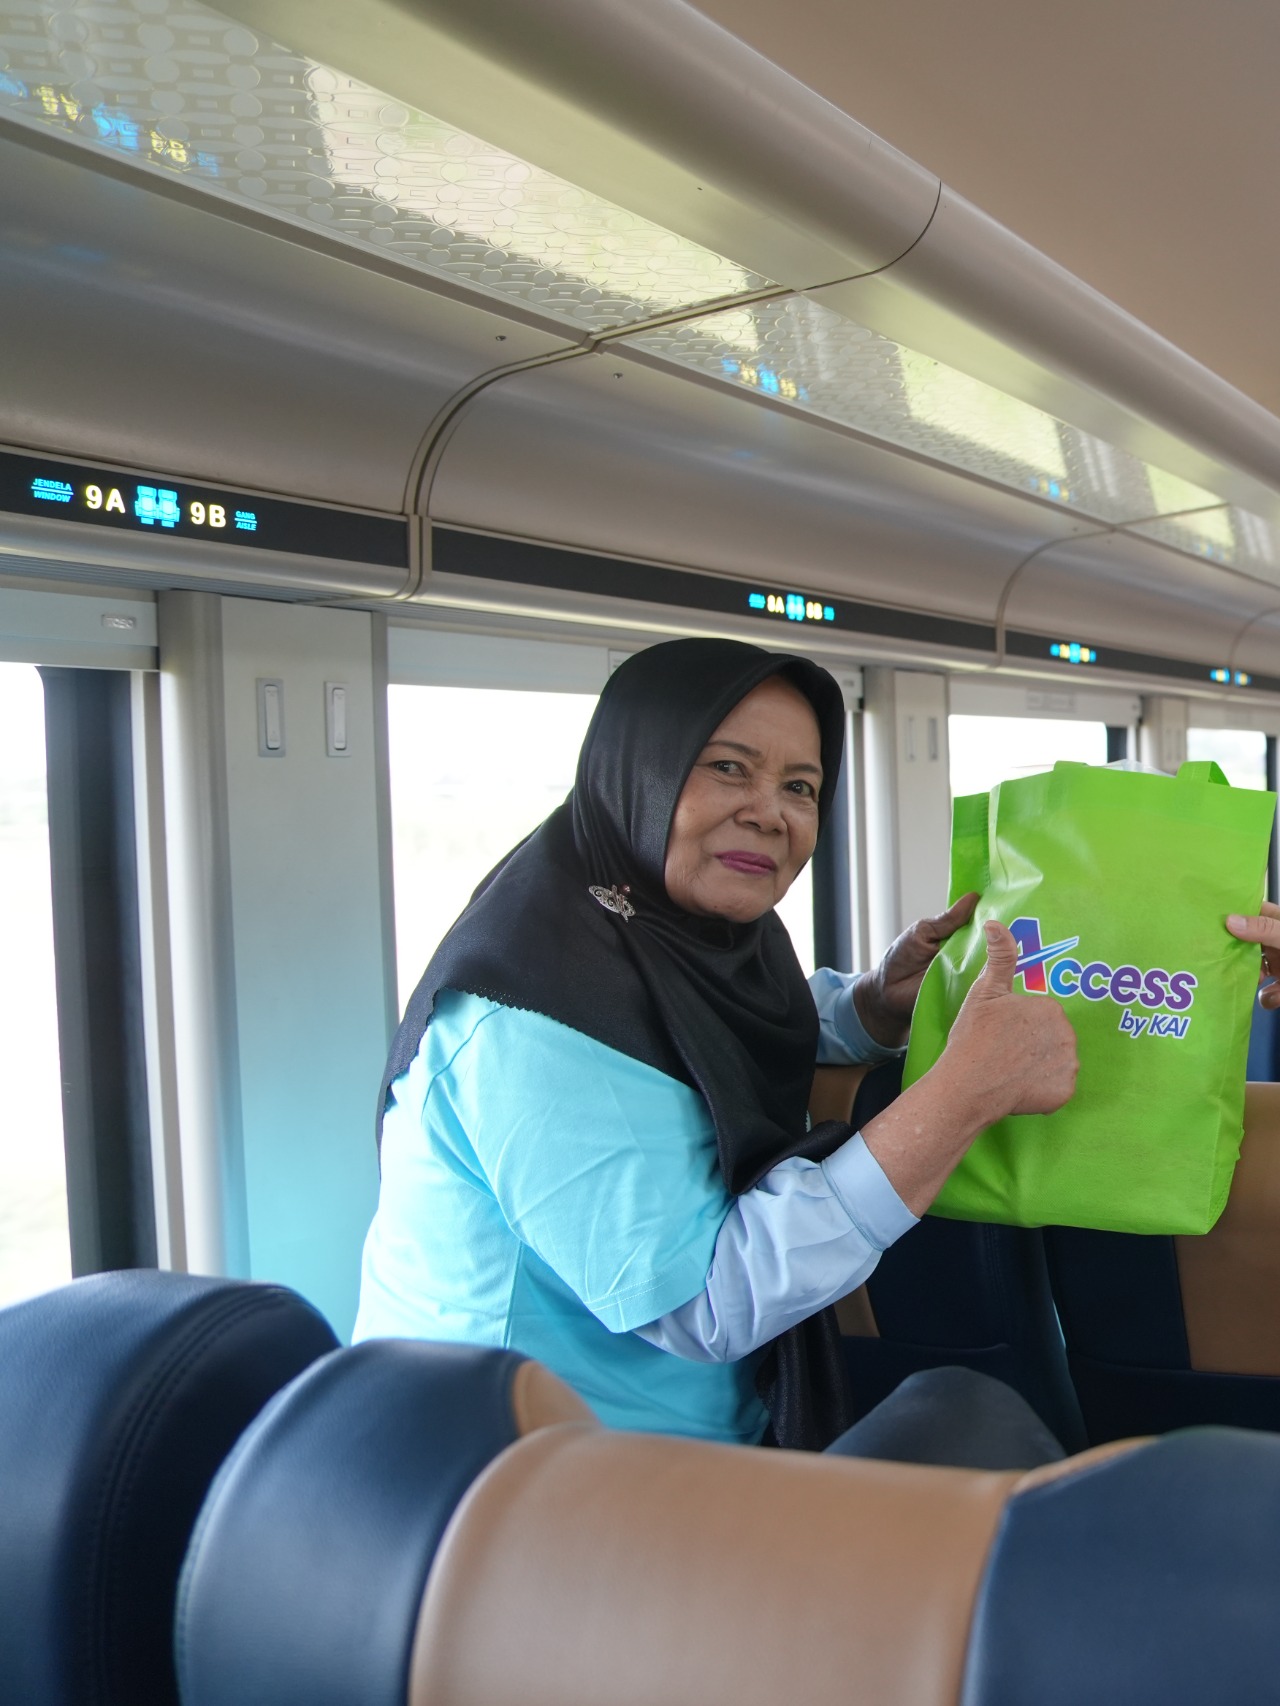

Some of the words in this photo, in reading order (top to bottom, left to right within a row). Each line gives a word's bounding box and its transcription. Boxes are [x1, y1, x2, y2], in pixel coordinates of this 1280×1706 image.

[33, 478, 73, 491] JENDELA
[33, 490, 71, 503] WINDOW
[85, 485, 126, 513] 9A
[190, 501, 226, 528] 9B
[236, 521, 257, 531] AISLE
[1119, 1008, 1147, 1039] by
[1149, 1013, 1191, 1039] KAI
